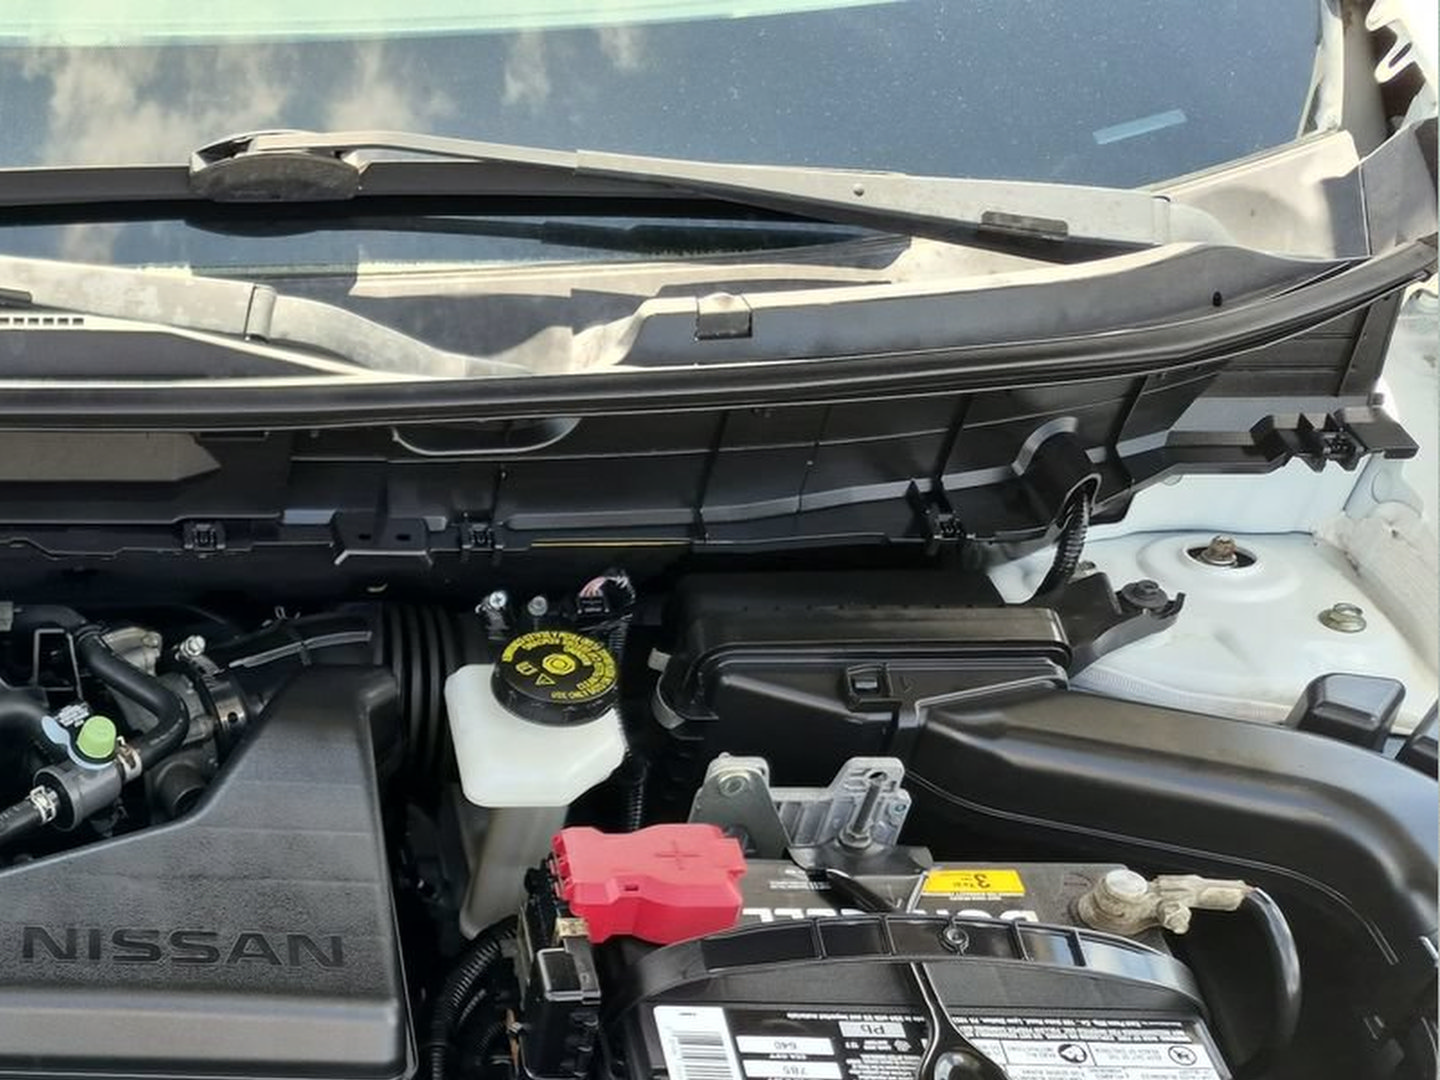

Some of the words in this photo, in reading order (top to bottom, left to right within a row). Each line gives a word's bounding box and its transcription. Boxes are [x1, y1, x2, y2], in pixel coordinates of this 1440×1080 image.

[974, 873, 991, 889] 3
[21, 926, 344, 968] NISSAN
[859, 1023, 887, 1036] Pb
